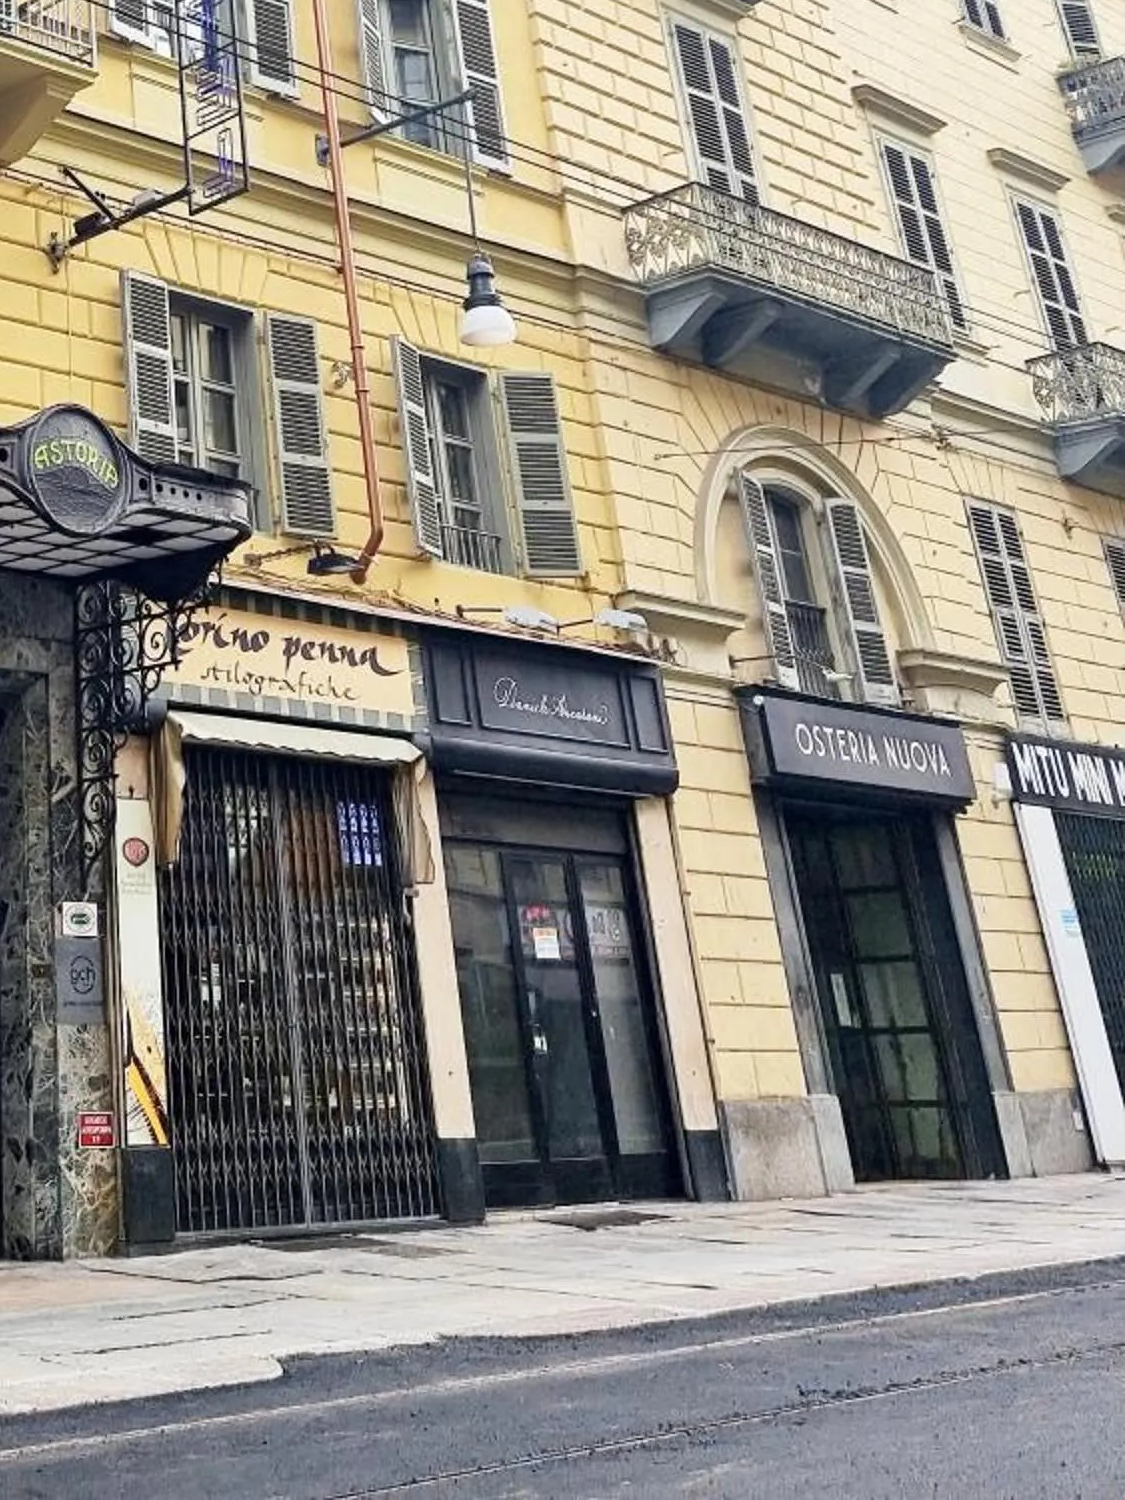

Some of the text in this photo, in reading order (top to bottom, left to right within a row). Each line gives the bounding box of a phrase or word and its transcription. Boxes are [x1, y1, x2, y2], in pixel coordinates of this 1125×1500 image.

[34, 439, 118, 489] ASTORIA
[200, 660, 358, 701] stilografiche
[282, 635, 404, 676] penna
[795, 723, 953, 778] OSTERIA NUOVA
[1011, 741, 1069, 798] MITU
[1067, 751, 1114, 805] MINI
